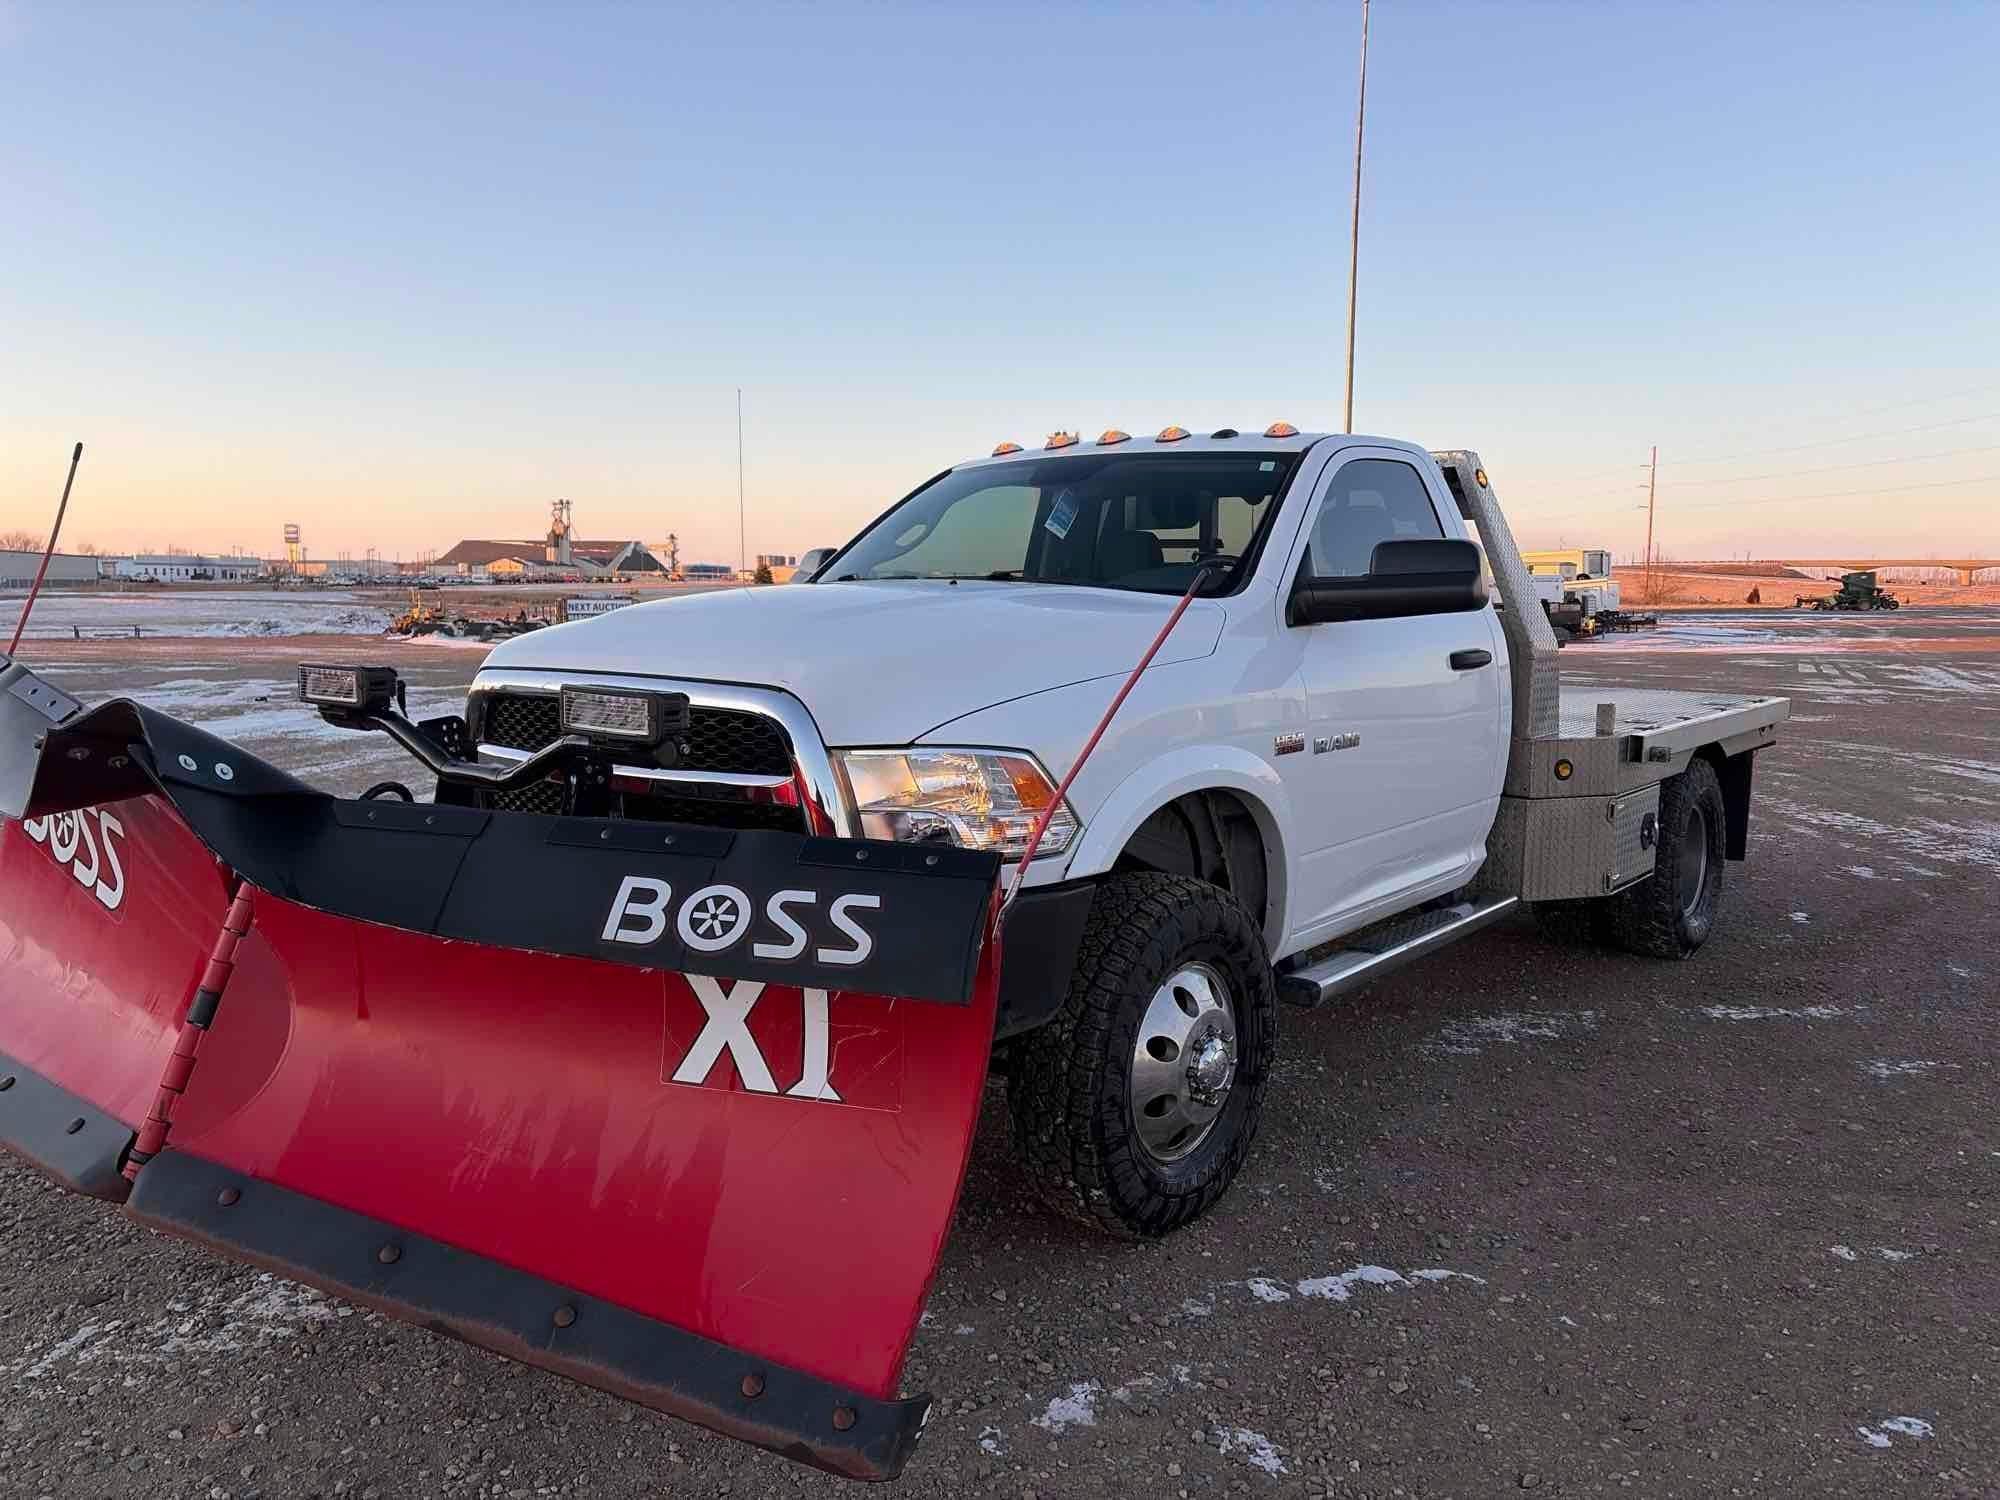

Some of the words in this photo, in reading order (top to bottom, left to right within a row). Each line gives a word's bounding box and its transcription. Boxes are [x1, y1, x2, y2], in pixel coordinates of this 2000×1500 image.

[568, 602, 590, 612] NEXT
[1313, 732, 1360, 754] RAM
[601, 875, 881, 965] BOSS
